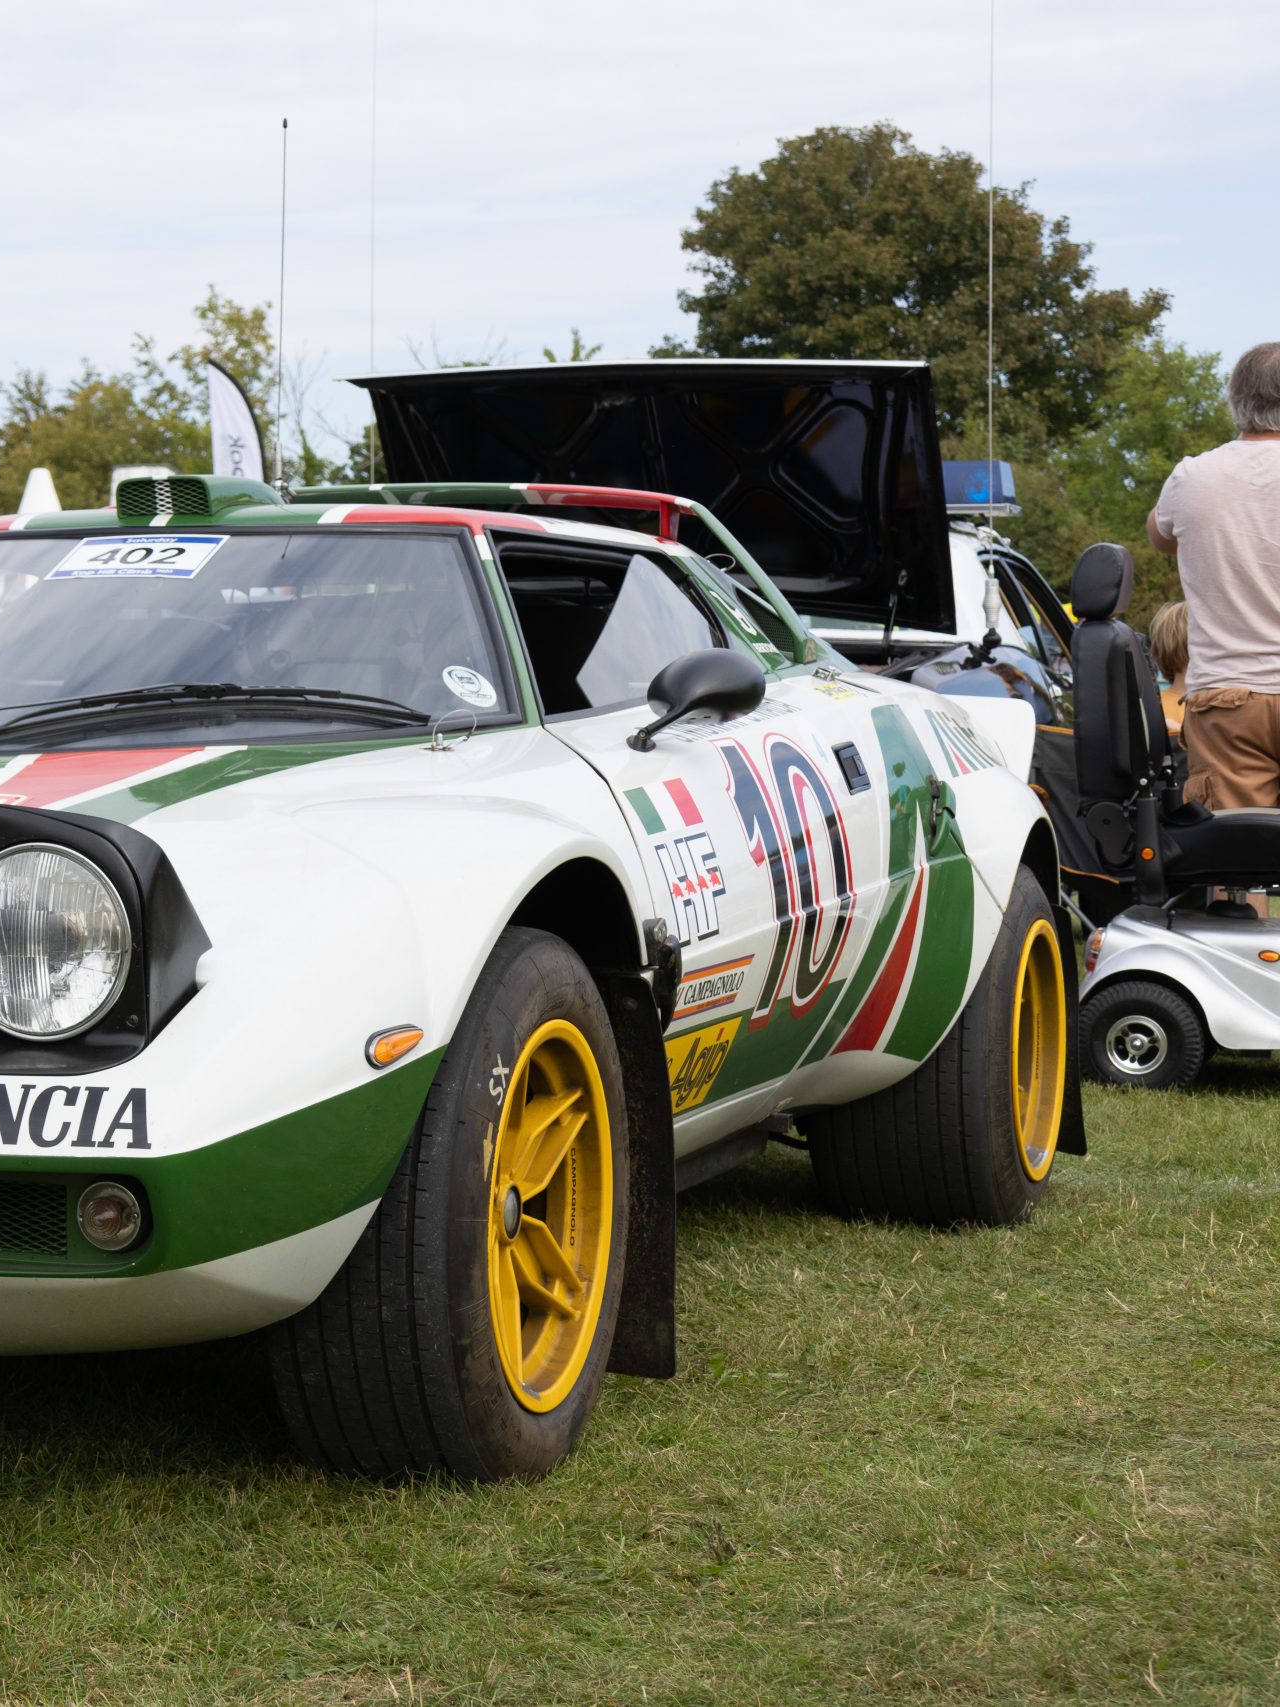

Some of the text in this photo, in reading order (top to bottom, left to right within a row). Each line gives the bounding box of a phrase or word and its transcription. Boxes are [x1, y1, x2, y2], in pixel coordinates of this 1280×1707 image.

[88, 547, 186, 565] 402
[712, 732, 858, 1032] 10
[683, 971, 745, 1005] CAMPAGNOLO
[672, 1027, 729, 1108] Agip
[569, 1147, 577, 1247] CAMPAGNOLO
